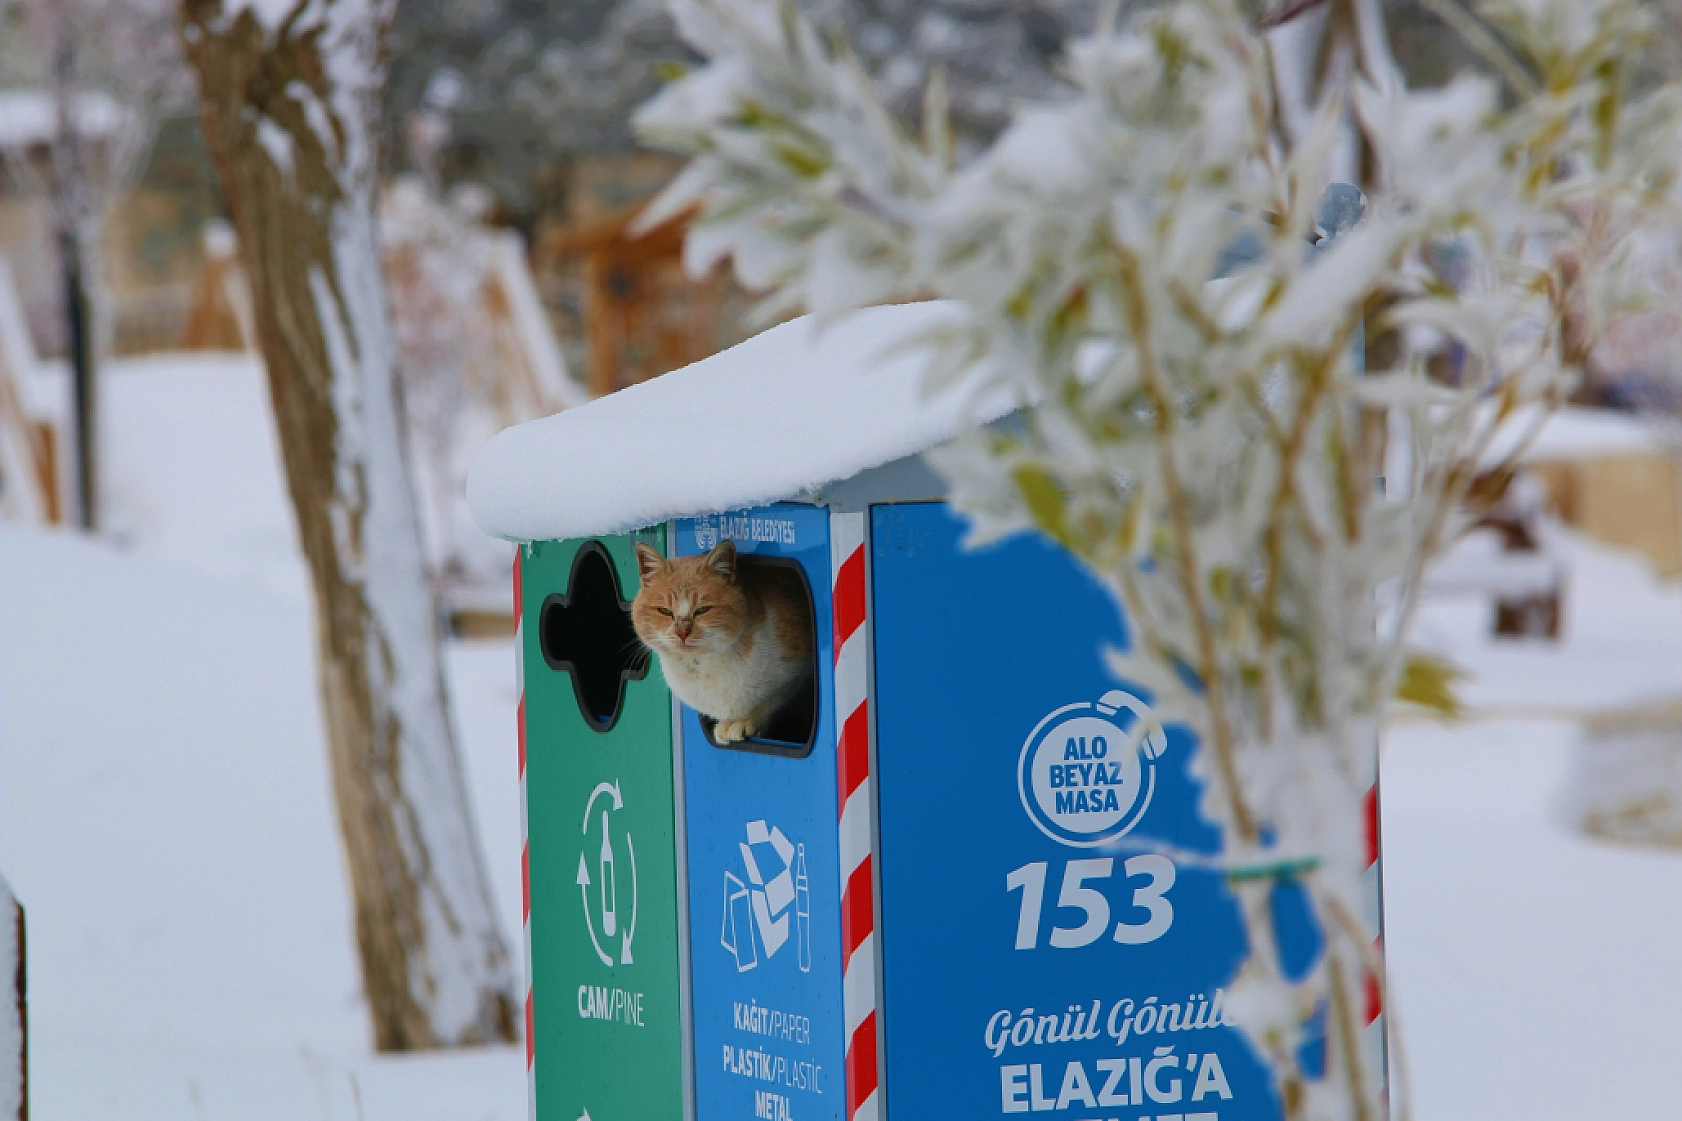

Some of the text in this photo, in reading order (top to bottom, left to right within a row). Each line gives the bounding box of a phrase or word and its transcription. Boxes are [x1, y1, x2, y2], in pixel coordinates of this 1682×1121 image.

[1063, 736, 1108, 761] ALO
[1050, 761, 1124, 788] BEYAZ
[1055, 788, 1120, 815] MASA
[1006, 854, 1176, 951] 153
[578, 984, 645, 1027] CAM/PINE
[733, 998, 811, 1044] KAĞIT/PAPER
[1000, 1044, 1234, 1114] ELAZIĞ'A
[754, 1089, 794, 1121] METAL
